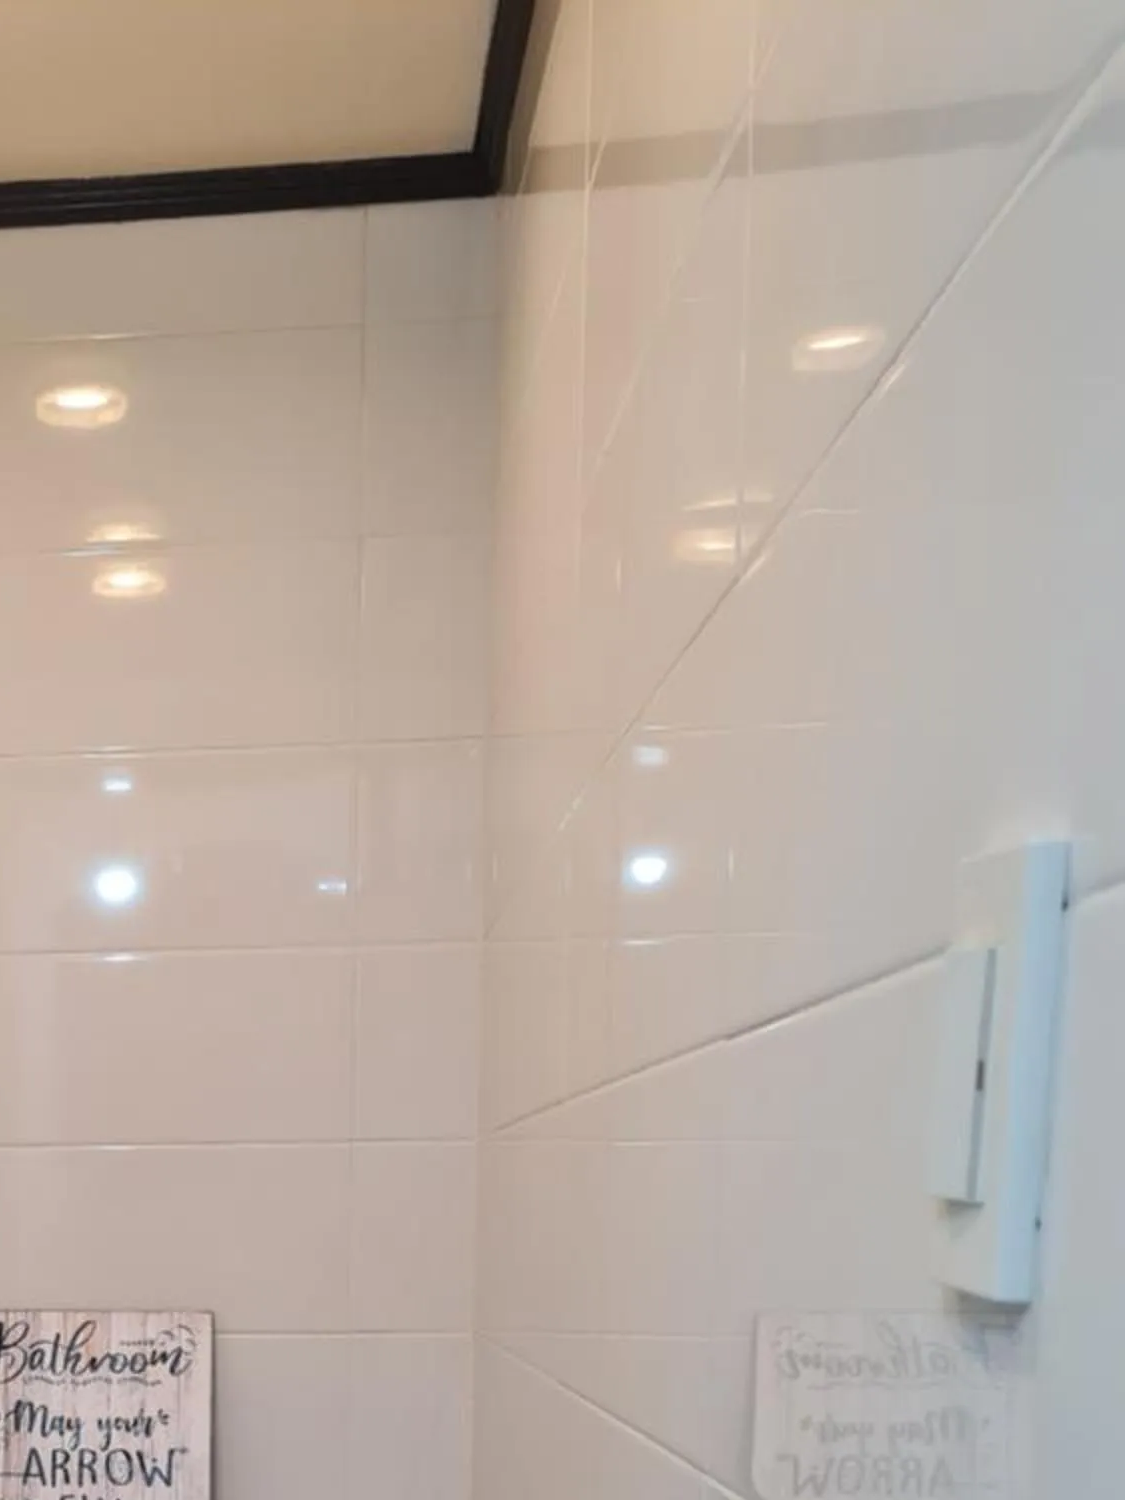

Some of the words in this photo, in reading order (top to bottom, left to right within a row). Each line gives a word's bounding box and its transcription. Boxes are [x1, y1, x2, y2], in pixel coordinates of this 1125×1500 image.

[6, 1400, 83, 1450] May
[97, 1409, 153, 1450] your
[22, 1448, 180, 1488] ARROW
